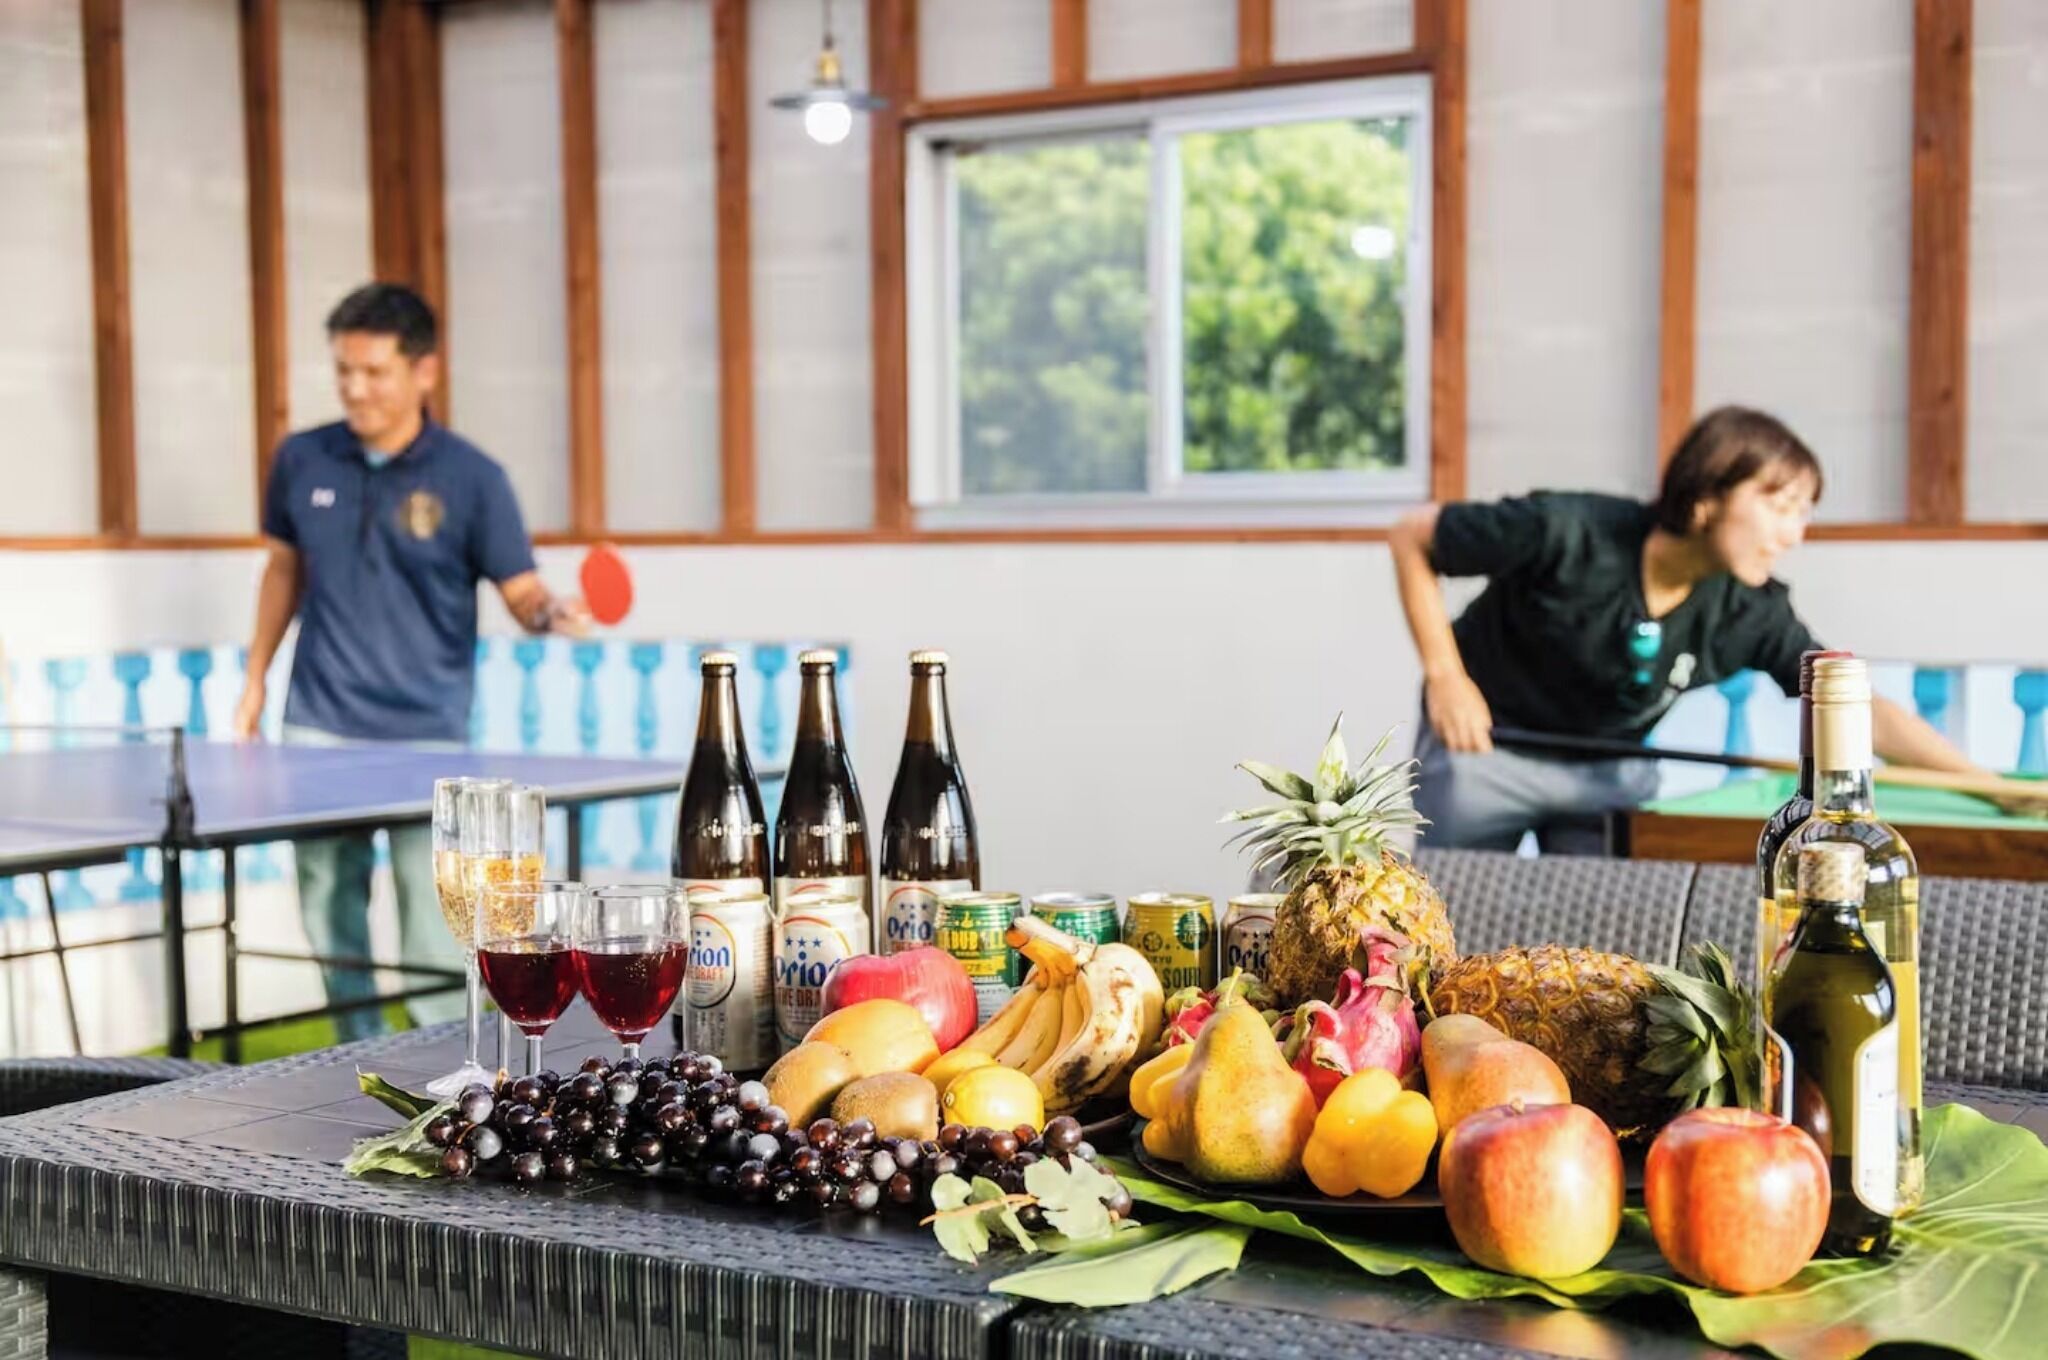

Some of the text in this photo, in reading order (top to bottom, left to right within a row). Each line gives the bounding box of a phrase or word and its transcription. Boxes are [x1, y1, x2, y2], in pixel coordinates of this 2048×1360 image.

[888, 913, 932, 940] Orio
[689, 939, 730, 967] rion
[797, 987, 821, 1007] DRA
